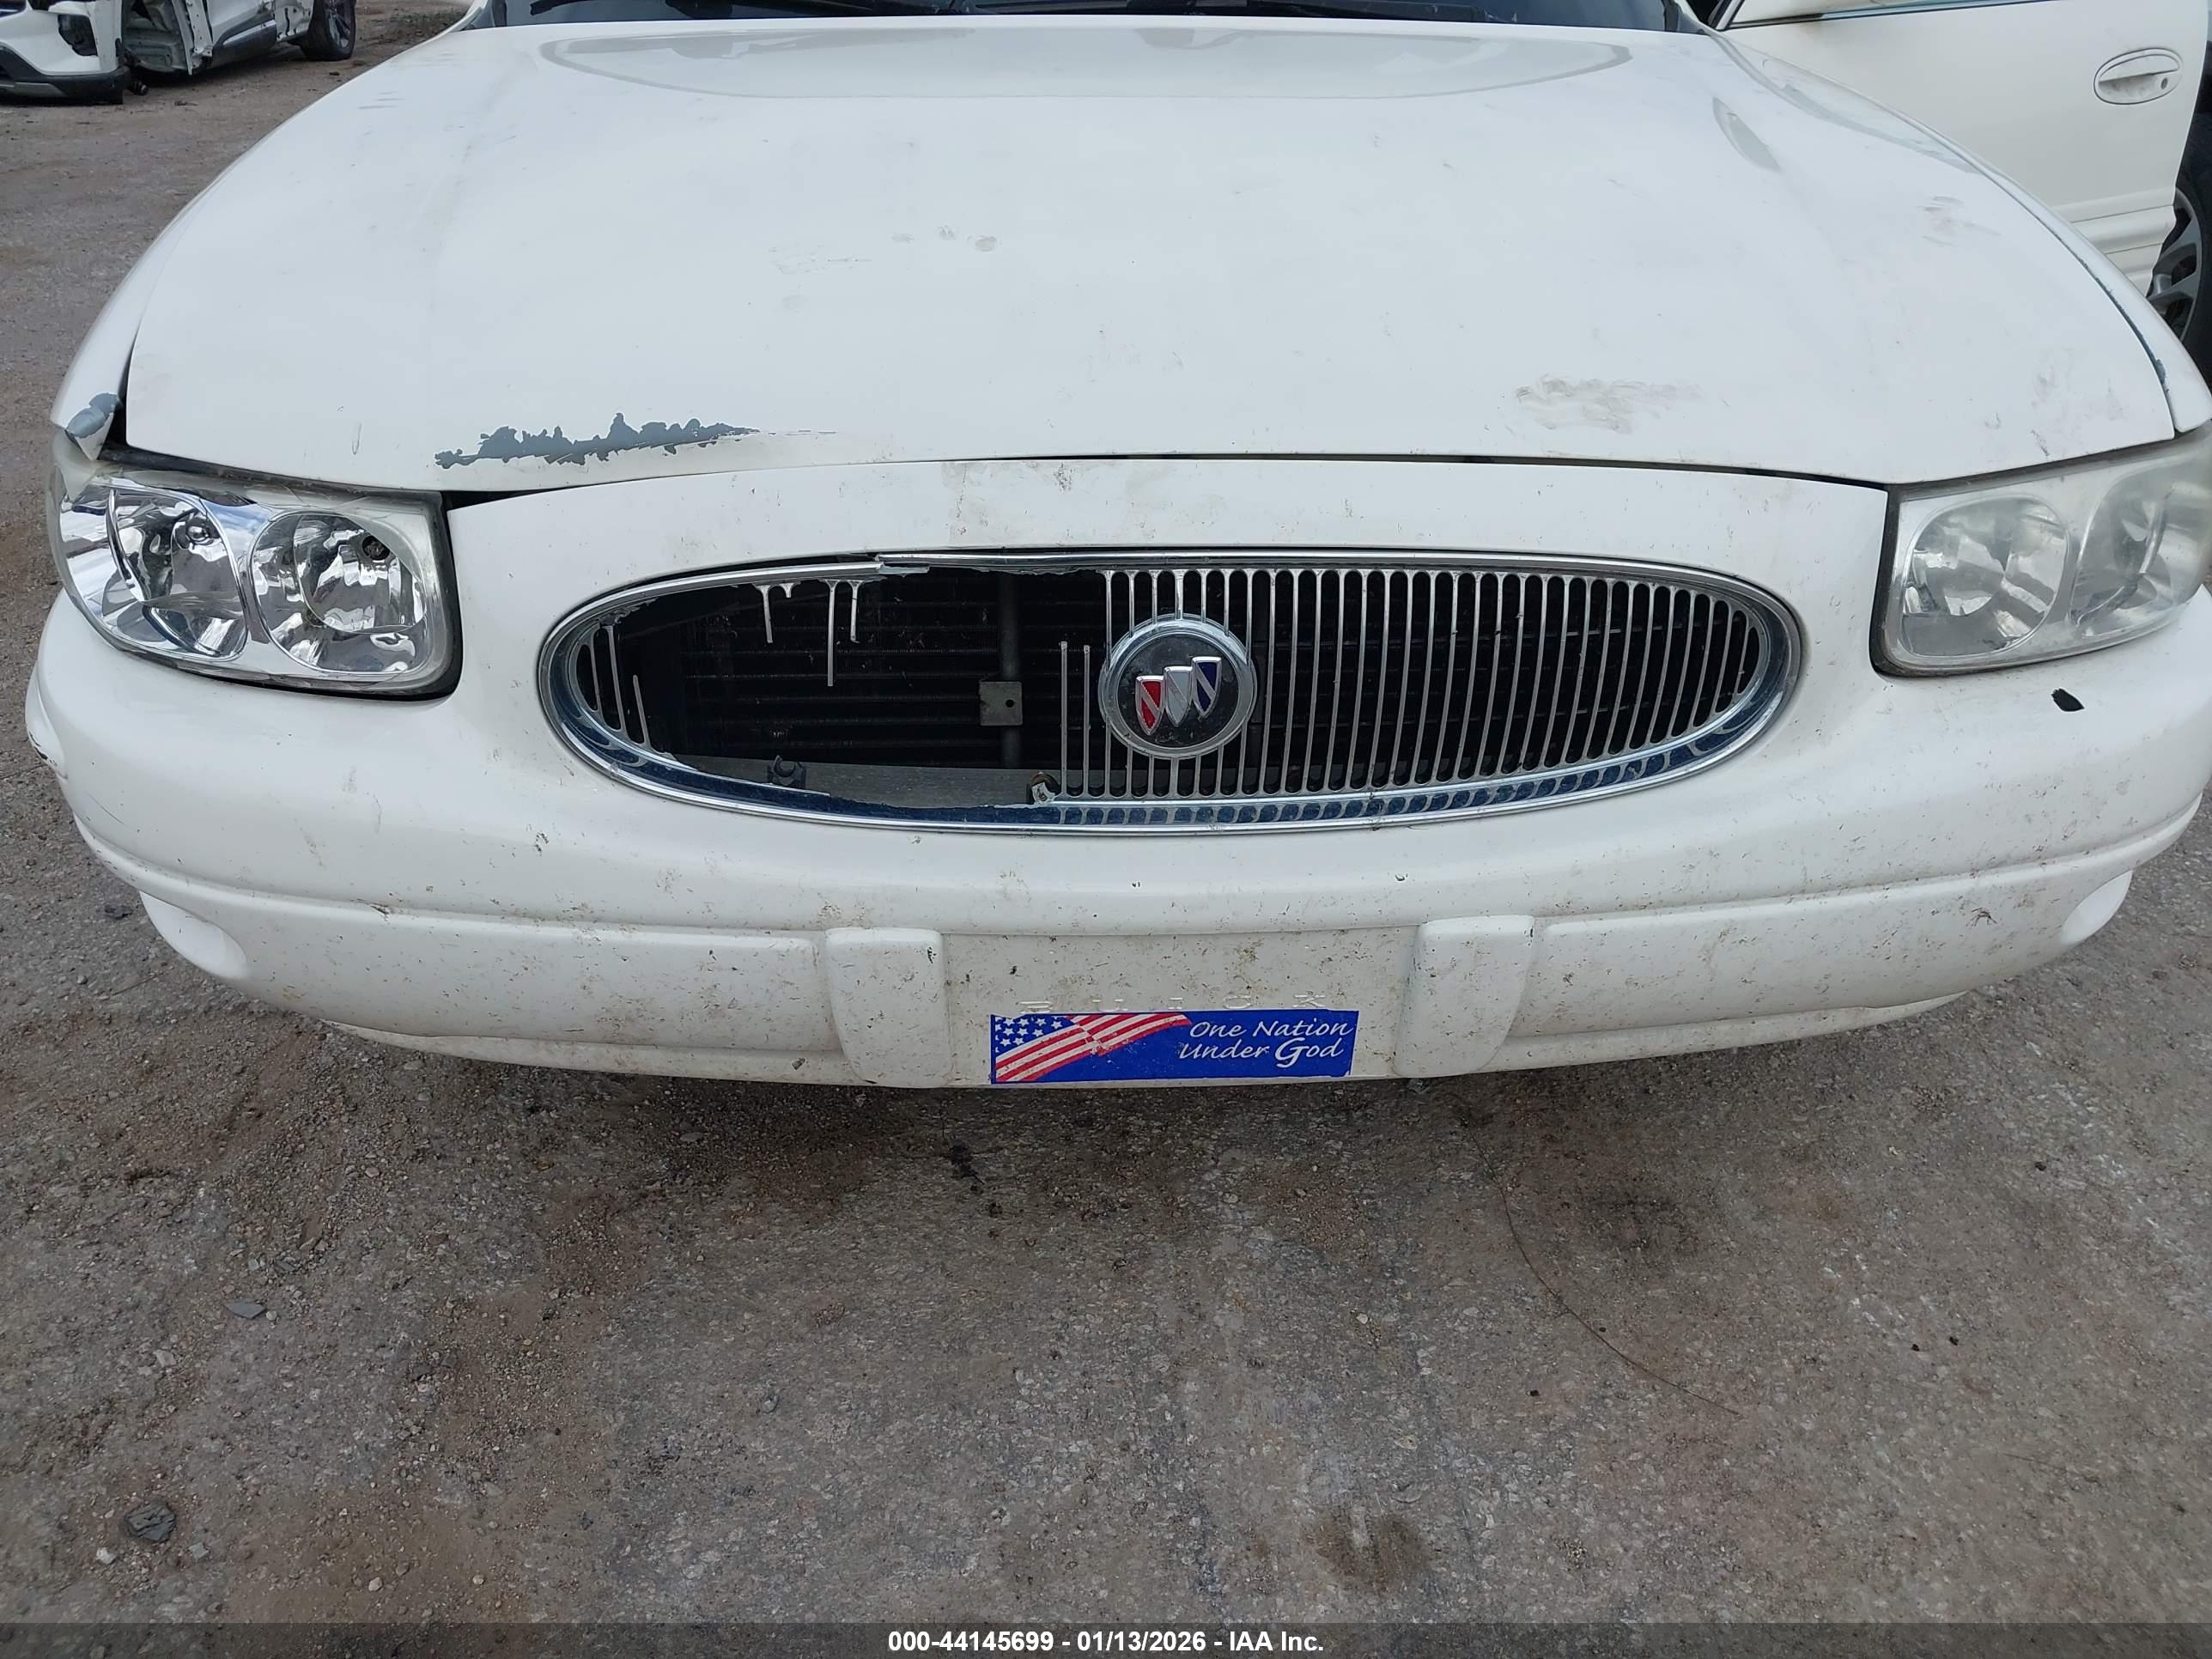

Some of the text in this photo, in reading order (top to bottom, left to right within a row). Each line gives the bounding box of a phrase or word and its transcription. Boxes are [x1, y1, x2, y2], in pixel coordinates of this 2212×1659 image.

[1190, 1018, 1353, 1038] One Nation
[1179, 1036, 1344, 1067] Under God
